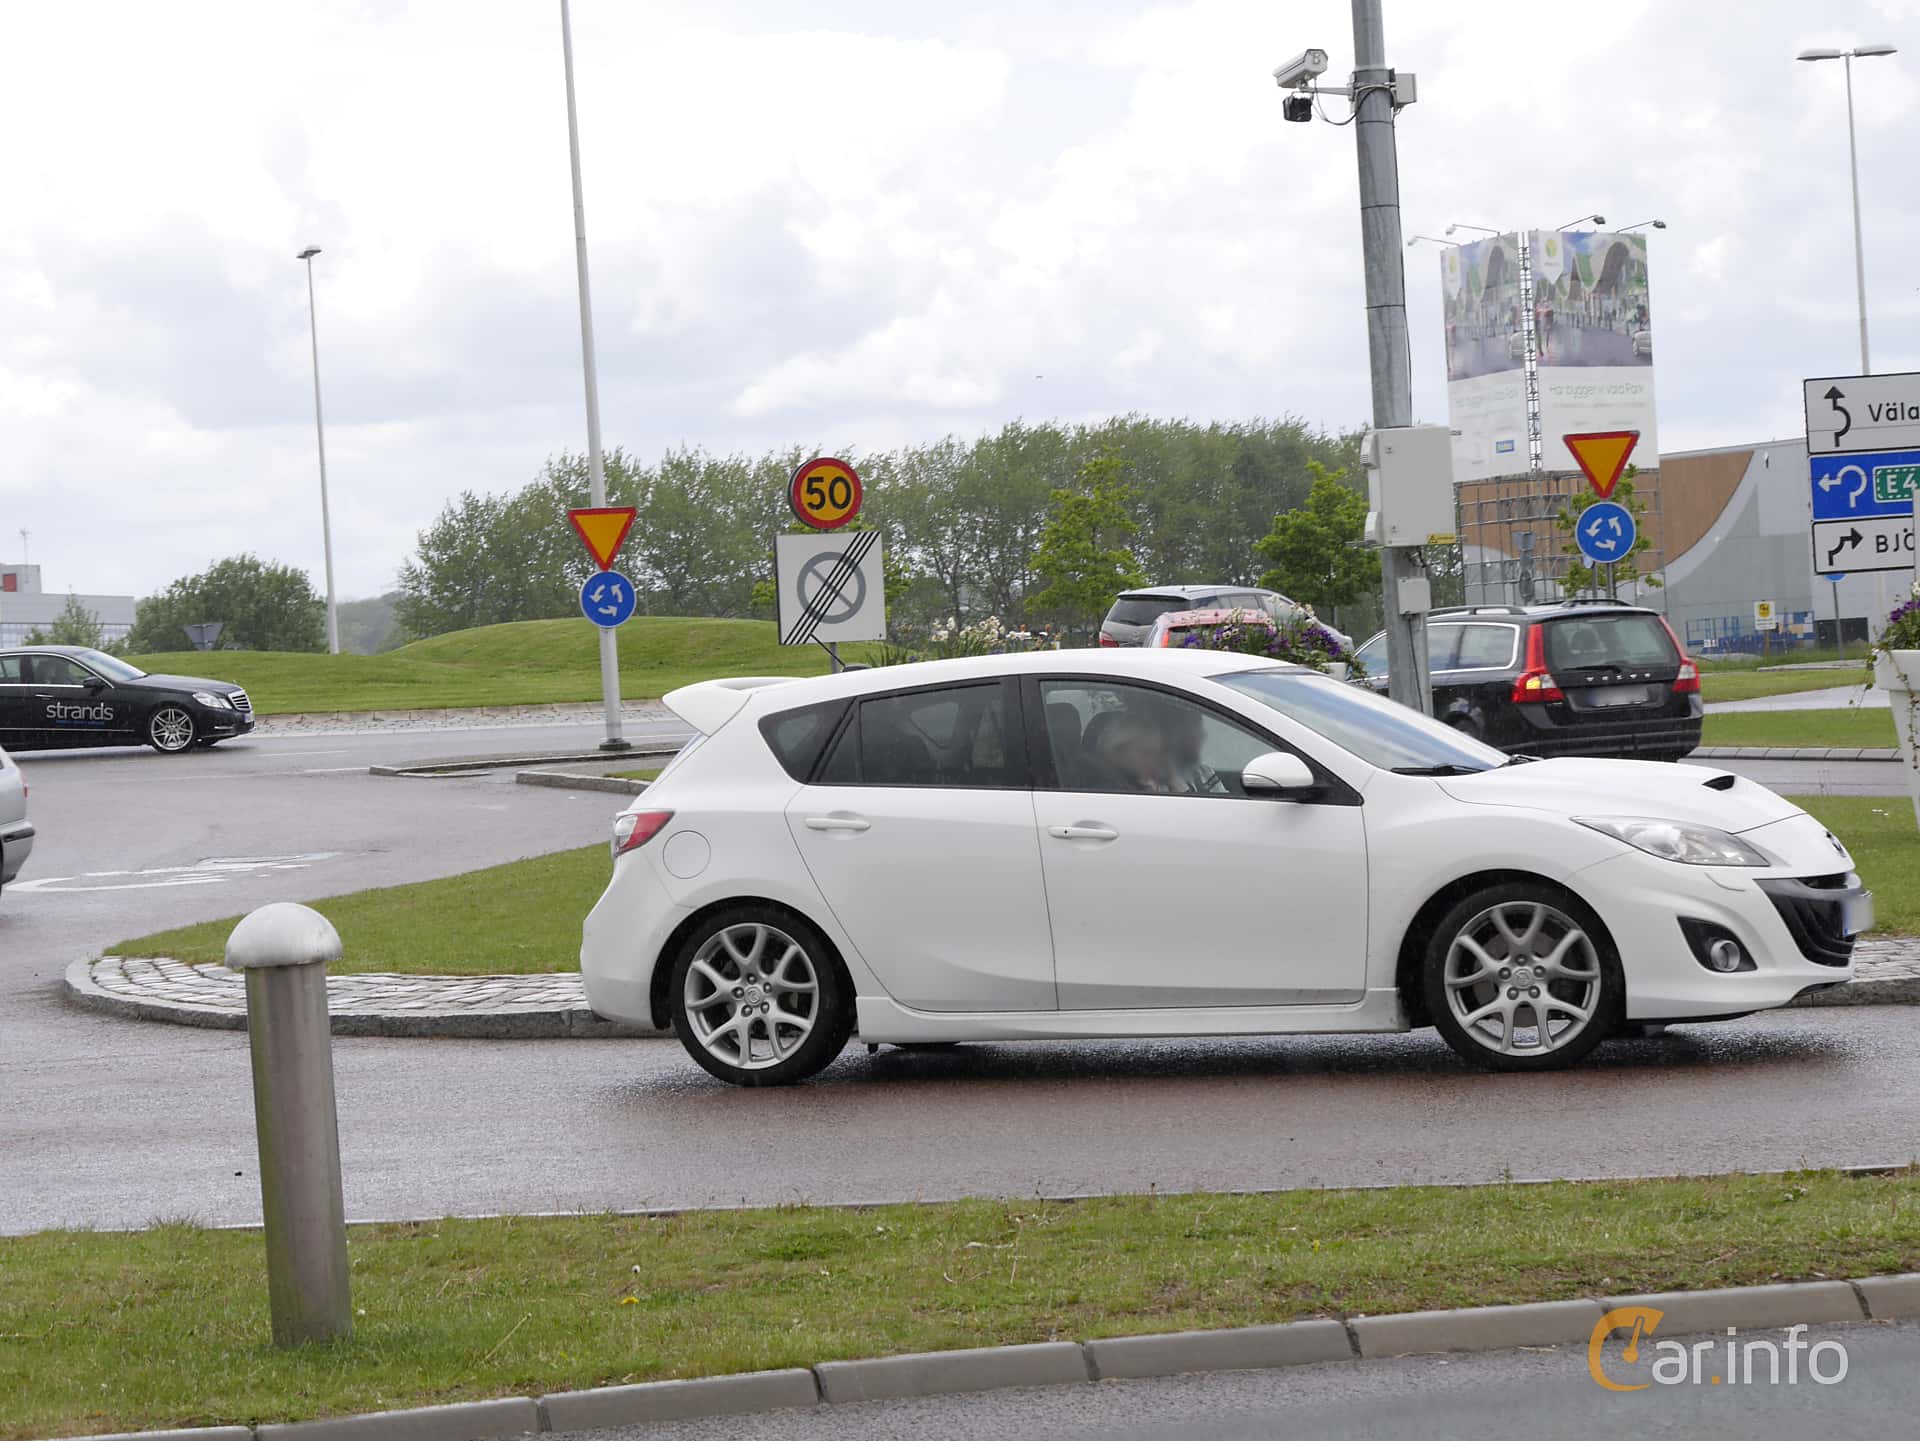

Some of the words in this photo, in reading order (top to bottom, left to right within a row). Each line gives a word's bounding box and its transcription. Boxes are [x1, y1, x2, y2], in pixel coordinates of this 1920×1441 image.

[1868, 402, 1920, 422] Väla
[806, 476, 852, 510] 50
[1585, 672, 1652, 683] VOLVO
[46, 701, 114, 721] strands
